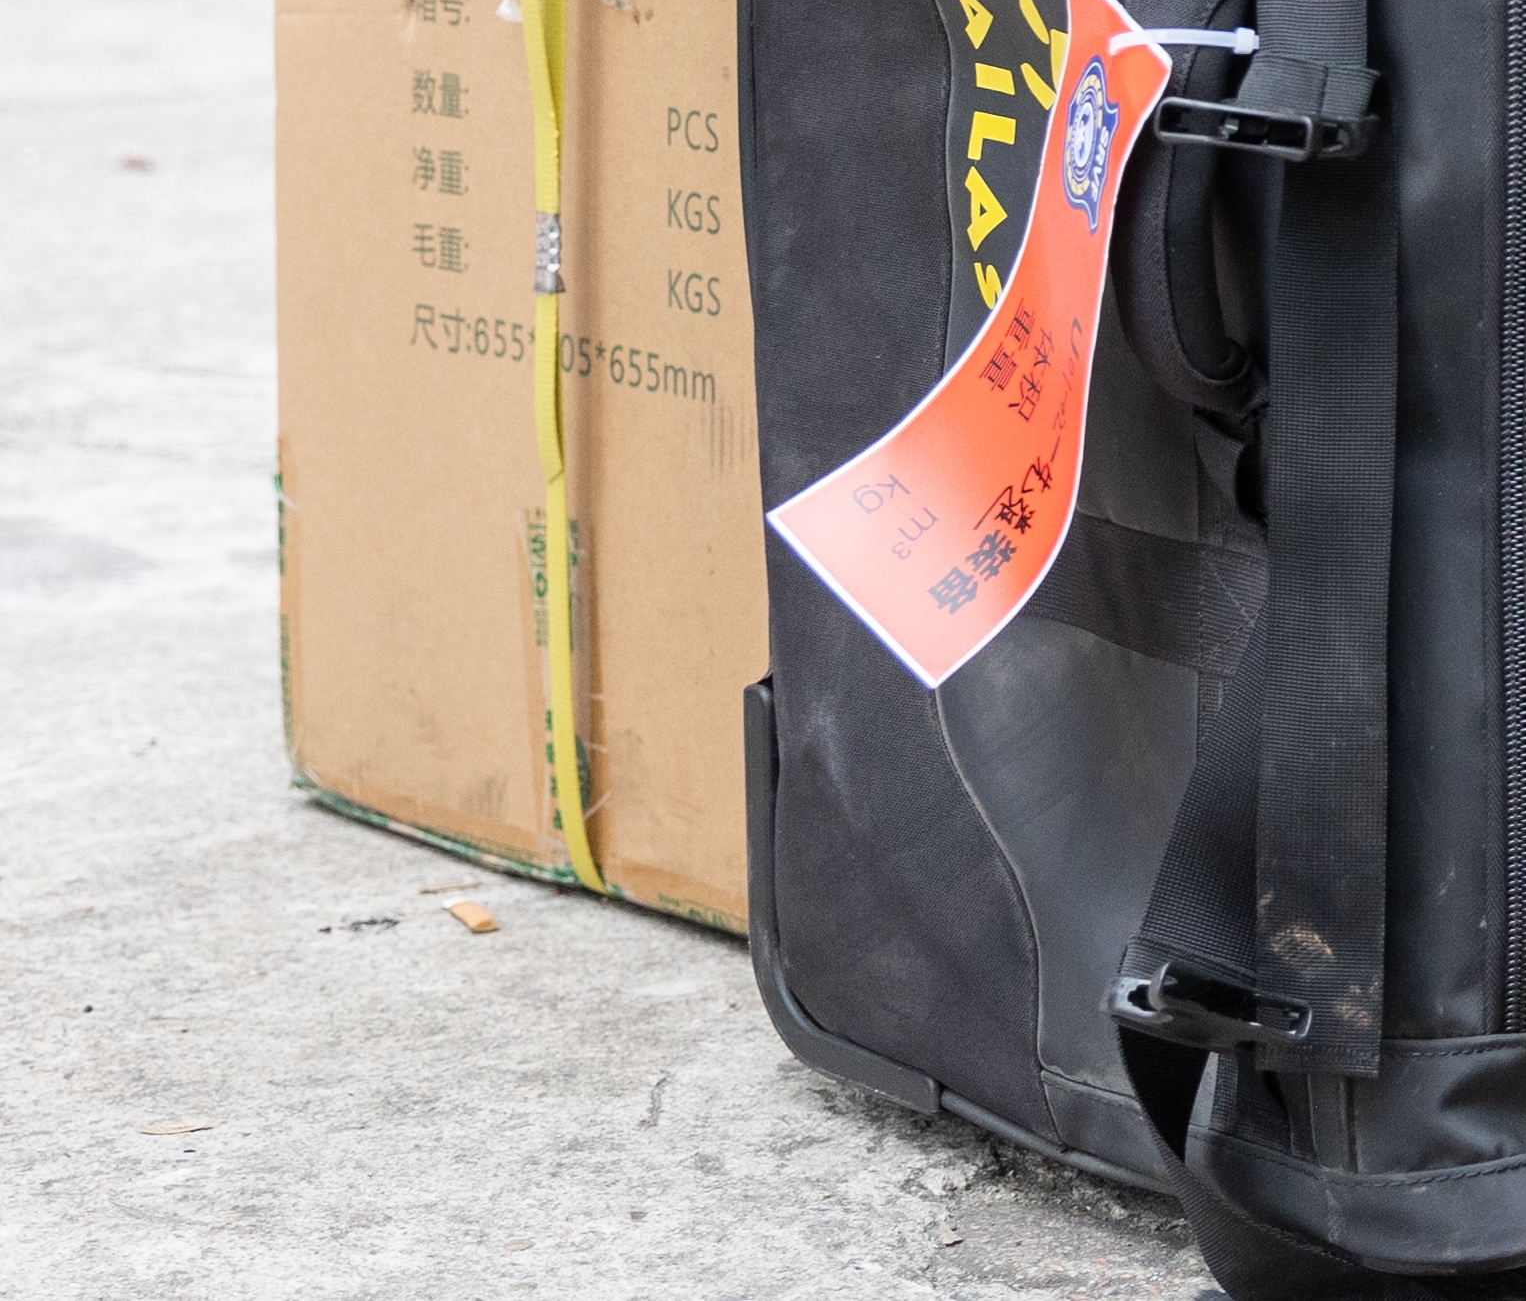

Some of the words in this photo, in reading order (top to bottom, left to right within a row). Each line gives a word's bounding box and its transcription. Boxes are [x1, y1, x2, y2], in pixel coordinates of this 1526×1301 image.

[667, 107, 719, 152] PCS
[1090, 126, 1110, 202] SRVF
[667, 188, 721, 235] KGS
[667, 269, 721, 317] KGS
[979, 298, 1036, 392] 重量
[1008, 329, 1054, 422] 体积
[853, 474, 910, 516] kg
